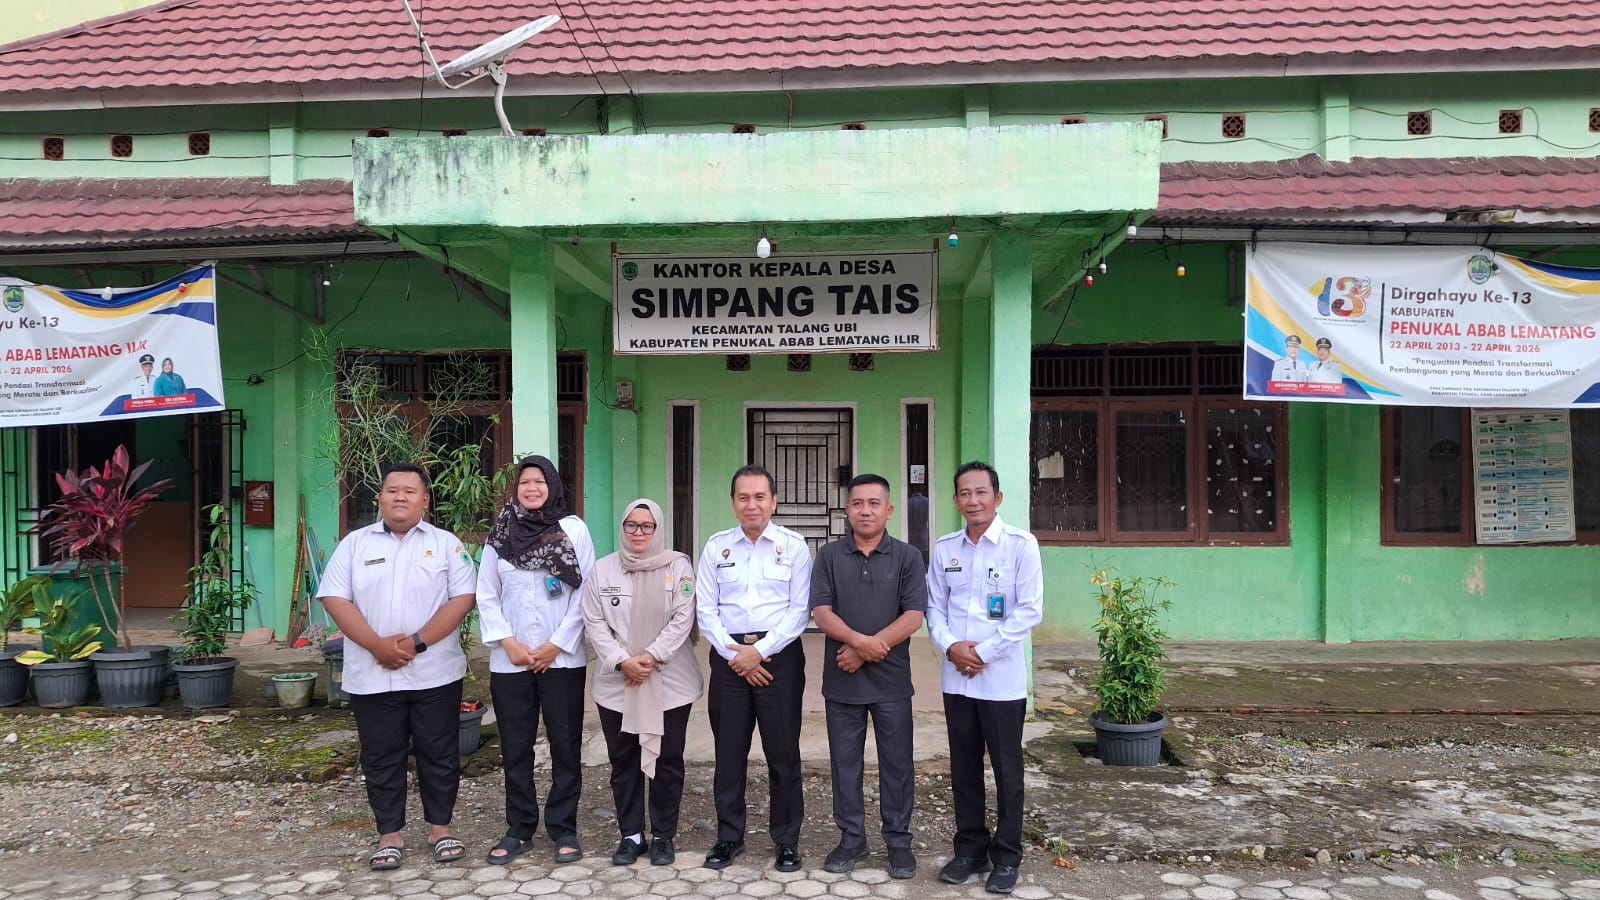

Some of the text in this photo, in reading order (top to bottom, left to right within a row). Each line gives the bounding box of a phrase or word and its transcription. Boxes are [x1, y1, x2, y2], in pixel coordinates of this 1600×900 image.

[653, 259, 896, 278] KANTOR KEPALA DESA
[631, 283, 920, 319] SIMPANG TAIS
[1391, 287, 1532, 304] Dirgahayu Ke-13
[1391, 307, 1454, 318] KABUPATEN
[19, 316, 60, 329] Ke-13
[692, 322, 857, 336] KECAMATAN TALANG UBI
[1391, 321, 1596, 339] PENUKAL ABAB LEMATANG
[629, 334, 920, 349] KABUPATEN PENUKAL ABAB LEMATANG ILIR
[1390, 340, 1402, 349] 22
[1405, 341, 1433, 350] APRIL
[1436, 342, 1461, 351] 2013
[1471, 343, 1482, 351] 22
[1485, 343, 1513, 352] APRIL
[1515, 344, 1541, 353] 2026
[6, 349, 42, 361] ABAB
[46, 343, 122, 361] LEMATANG
[11, 367, 21, 375] 22
[24, 366, 49, 375] APRIL
[52, 365, 73, 374] 2026
[1497, 359, 1553, 367] Transformasi
[1389, 366, 1448, 375] Pembangunan
[1450, 369, 1471, 377] yang
[1505, 368, 1522, 377] dan
